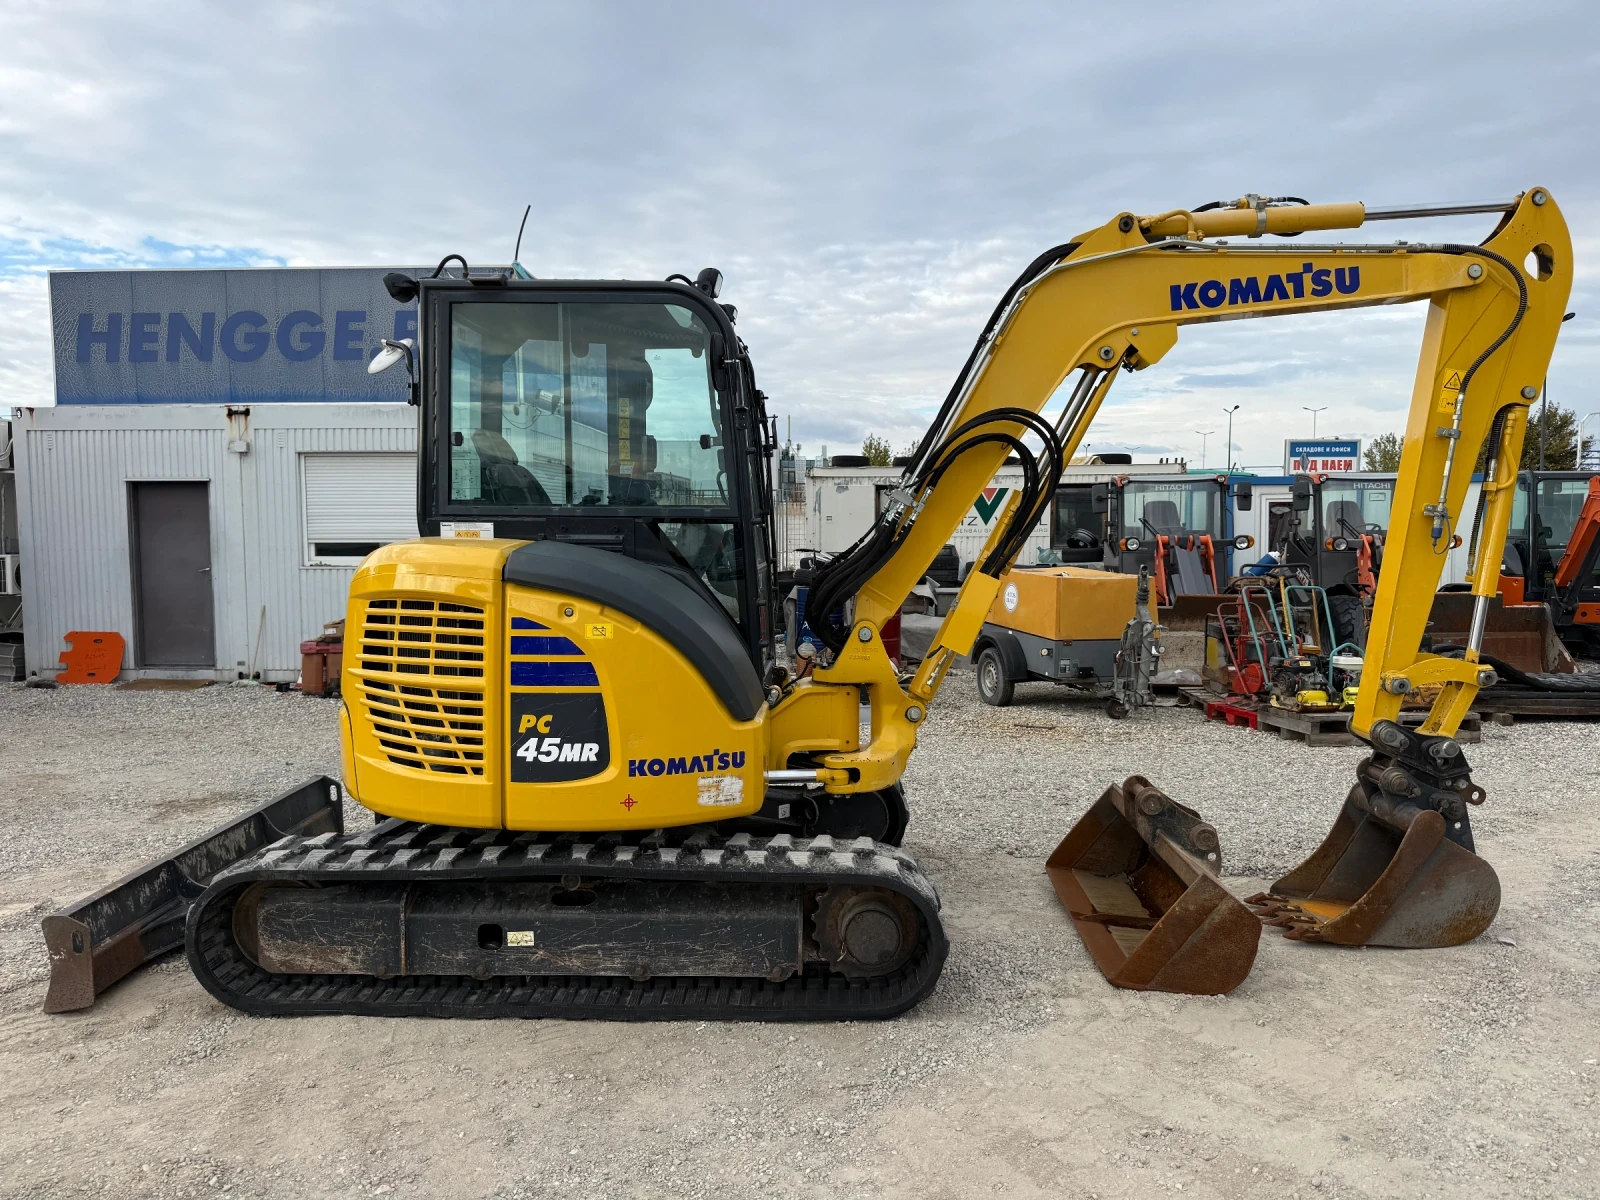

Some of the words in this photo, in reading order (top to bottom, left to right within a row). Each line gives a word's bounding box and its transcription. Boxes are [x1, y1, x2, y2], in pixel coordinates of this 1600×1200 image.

[1170, 263, 1360, 311] KOMATSU
[1293, 460, 1317, 472] ПД
[1322, 460, 1352, 470] НАЕМ
[1353, 482, 1391, 490] HITACHI
[518, 714, 553, 734] PC
[516, 737, 600, 763] 45MR
[628, 748, 746, 777] KOMATSU
